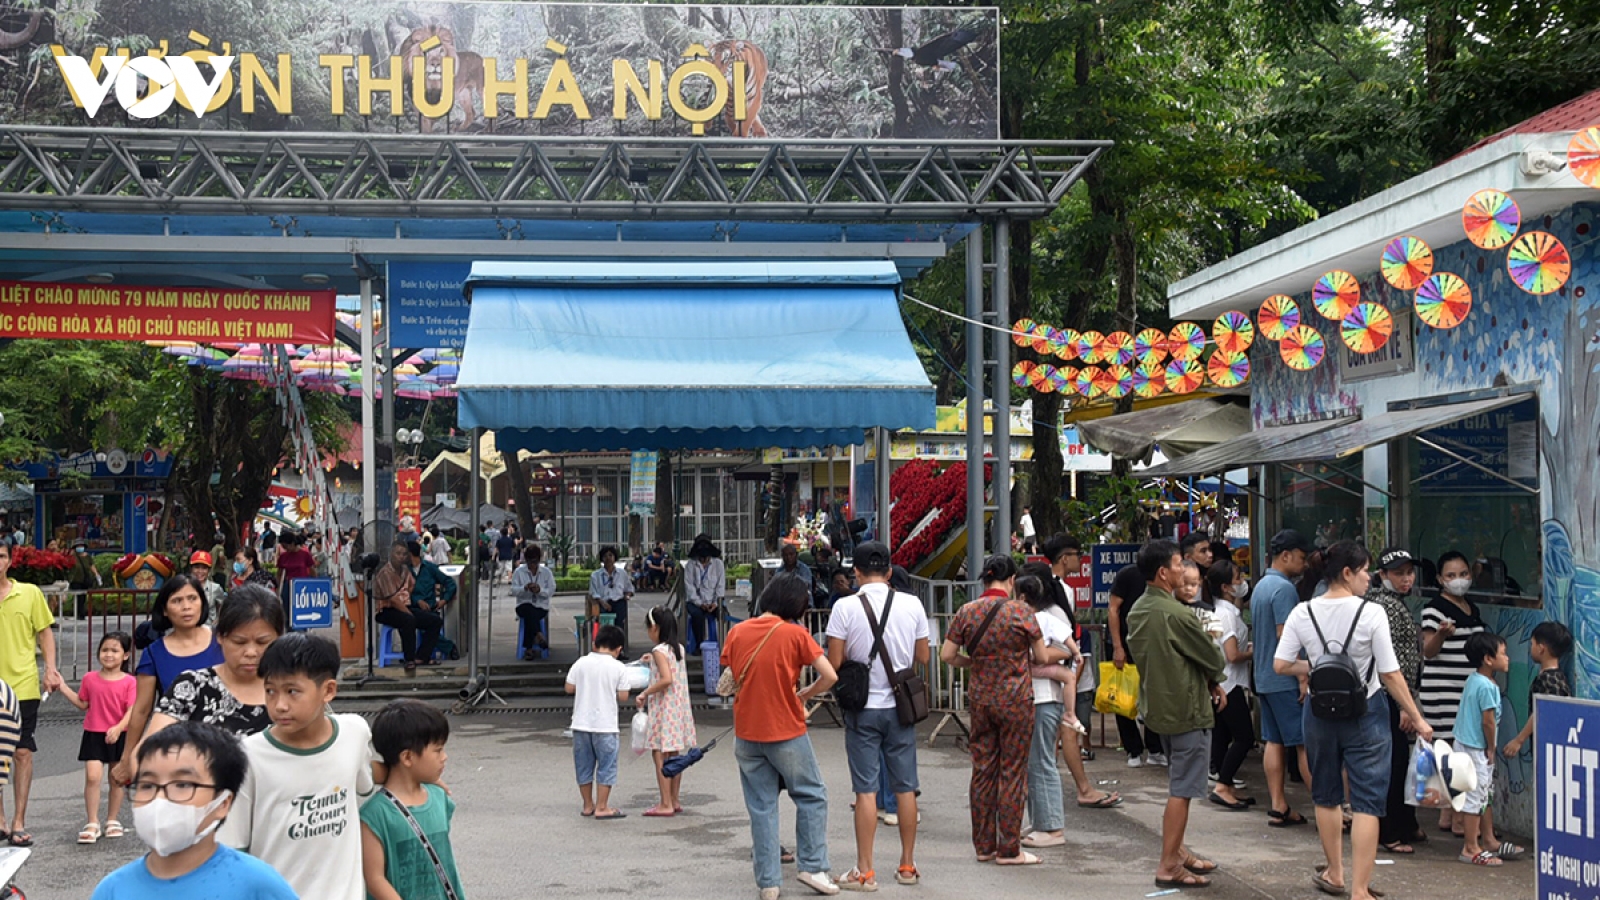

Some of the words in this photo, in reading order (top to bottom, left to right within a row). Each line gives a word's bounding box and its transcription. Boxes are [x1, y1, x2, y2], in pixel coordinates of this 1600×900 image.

[319, 35, 454, 118] THÚ
[483, 38, 592, 119] HÀ
[612, 43, 747, 135] NỘI
[1, 284, 31, 306] LIỆT
[35, 285, 73, 305] CHÀO
[77, 286, 120, 306] MỪNG
[125, 291, 142, 307] 79
[145, 289, 178, 308] NĂM
[182, 289, 220, 309] NGÀY
[223, 289, 260, 311] QUỐC
[264, 292, 311, 312] KHÁNH
[17, 312, 57, 335] CỘNG
[61, 312, 90, 333] HÒA
[94, 314, 113, 334] XÃ
[117, 315, 141, 337] HỘI
[145, 314, 173, 335] CHỦ
[177, 317, 220, 337] NGHĨA
[223, 318, 253, 340] VIỆT
[256, 322, 293, 338] NAM!
[1100, 551, 1111, 565] XE
[1113, 551, 1130, 565] TAXI
[295, 586, 309, 609] LỐI
[310, 588, 328, 608] VÀO
[1546, 718, 1598, 839] HẾT
[291, 787, 348, 817] Tennis
[308, 805, 346, 825] Court
[288, 819, 347, 841] Champ
[1555, 854, 1580, 888] NGHỊ
